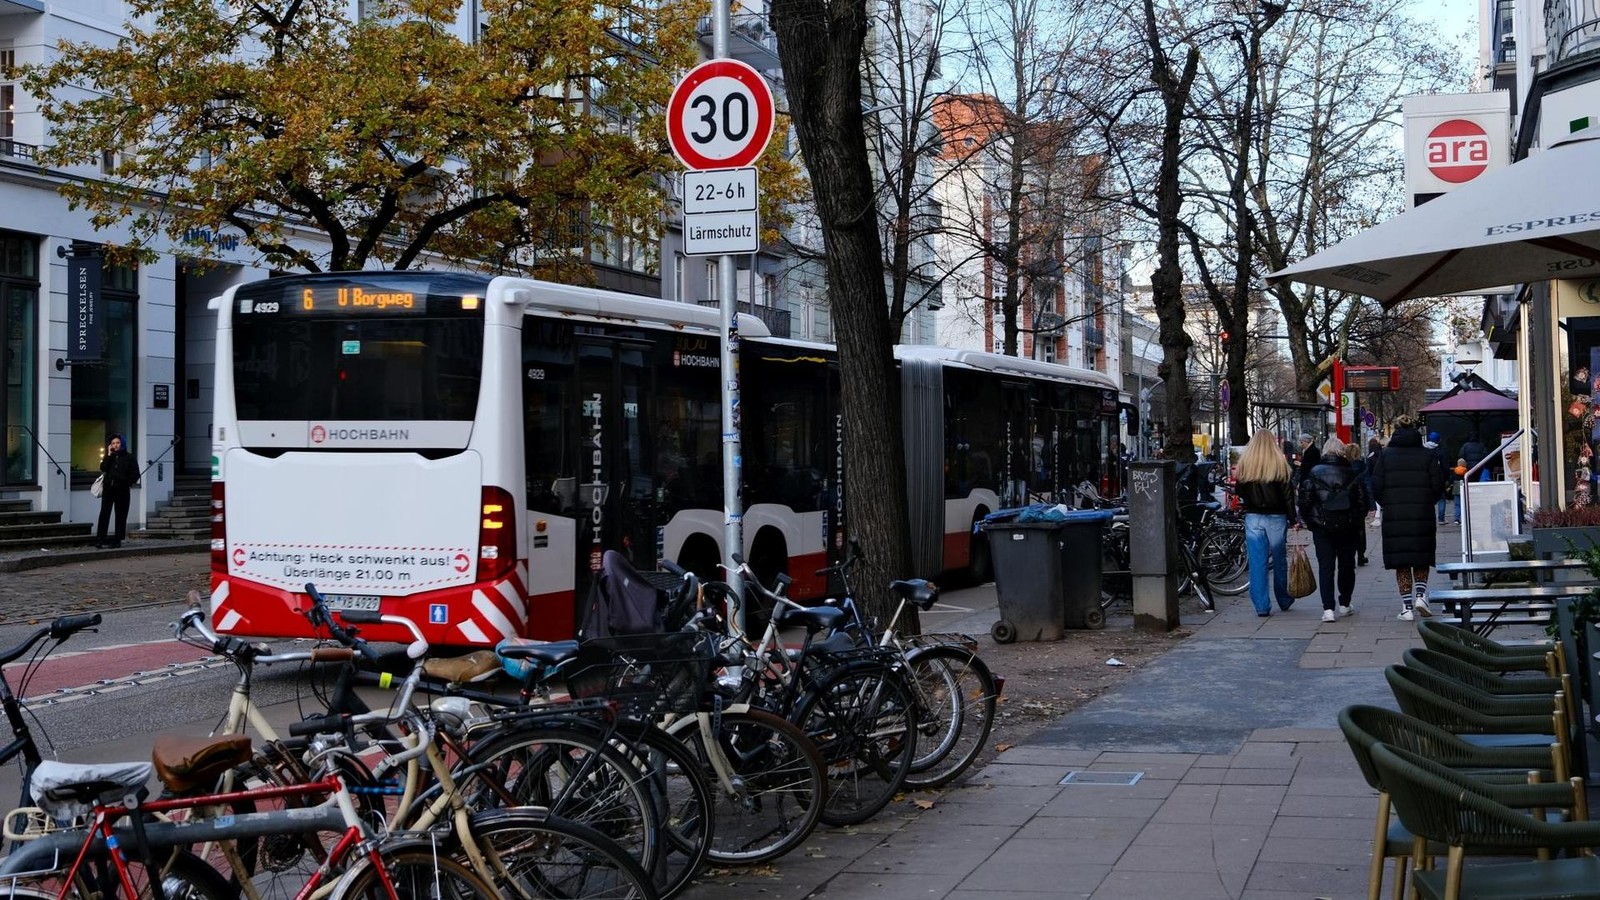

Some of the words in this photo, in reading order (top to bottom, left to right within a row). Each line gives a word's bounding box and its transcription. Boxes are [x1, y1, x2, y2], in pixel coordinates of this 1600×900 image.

[690, 92, 749, 144] 30
[1428, 140, 1488, 163] ara
[690, 225, 752, 241] Lärmschutz
[303, 288, 313, 310] 6
[337, 287, 347, 306] U
[352, 287, 413, 308] Borgweg
[79, 266, 87, 351] SPRECKELSEN
[254, 302, 280, 313] 4929
[681, 354, 720, 368] HOCHBAHN
[527, 368, 545, 380] 4929
[329, 429, 409, 440] HOCHBAHN
[592, 392, 602, 544] HOCHBAHN
[249, 551, 305, 565] Achtung:
[310, 553, 343, 563] Heck
[348, 554, 416, 566] schwenkt
[420, 556, 450, 566] aus!
[284, 565, 351, 581] Überlänge
[356, 569, 393, 581] 21,00
[398, 572, 411, 580] m
[354, 597, 378, 609] 4929
